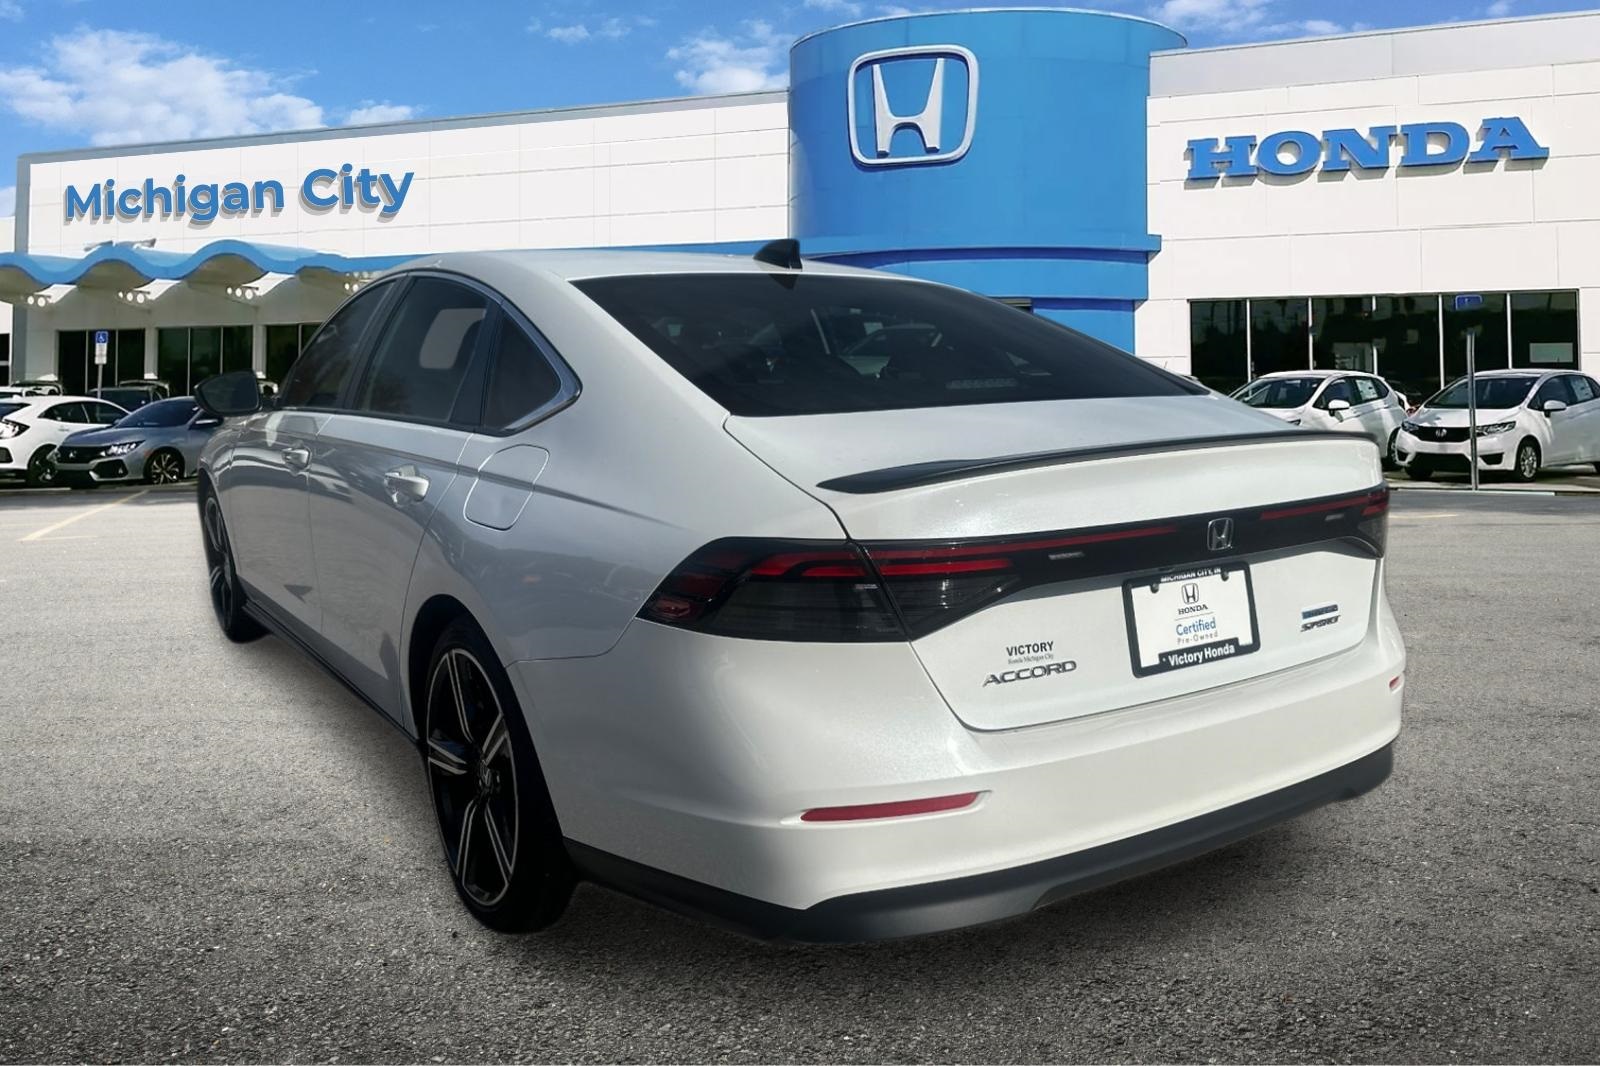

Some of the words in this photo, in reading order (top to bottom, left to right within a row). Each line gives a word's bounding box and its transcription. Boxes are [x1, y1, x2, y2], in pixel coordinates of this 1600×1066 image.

[1186, 116, 1549, 182] HONDA
[66, 174, 285, 224] Michigan
[302, 163, 415, 216] City
[1178, 604, 1209, 615] HONDA
[1176, 617, 1216, 636] Certified
[1177, 631, 1219, 645] Pre-Owned
[1006, 641, 1054, 657] VICTORY
[1168, 651, 1203, 667] Victory
[1204, 643, 1236, 659] Honda
[983, 660, 1077, 688] ACCORD
